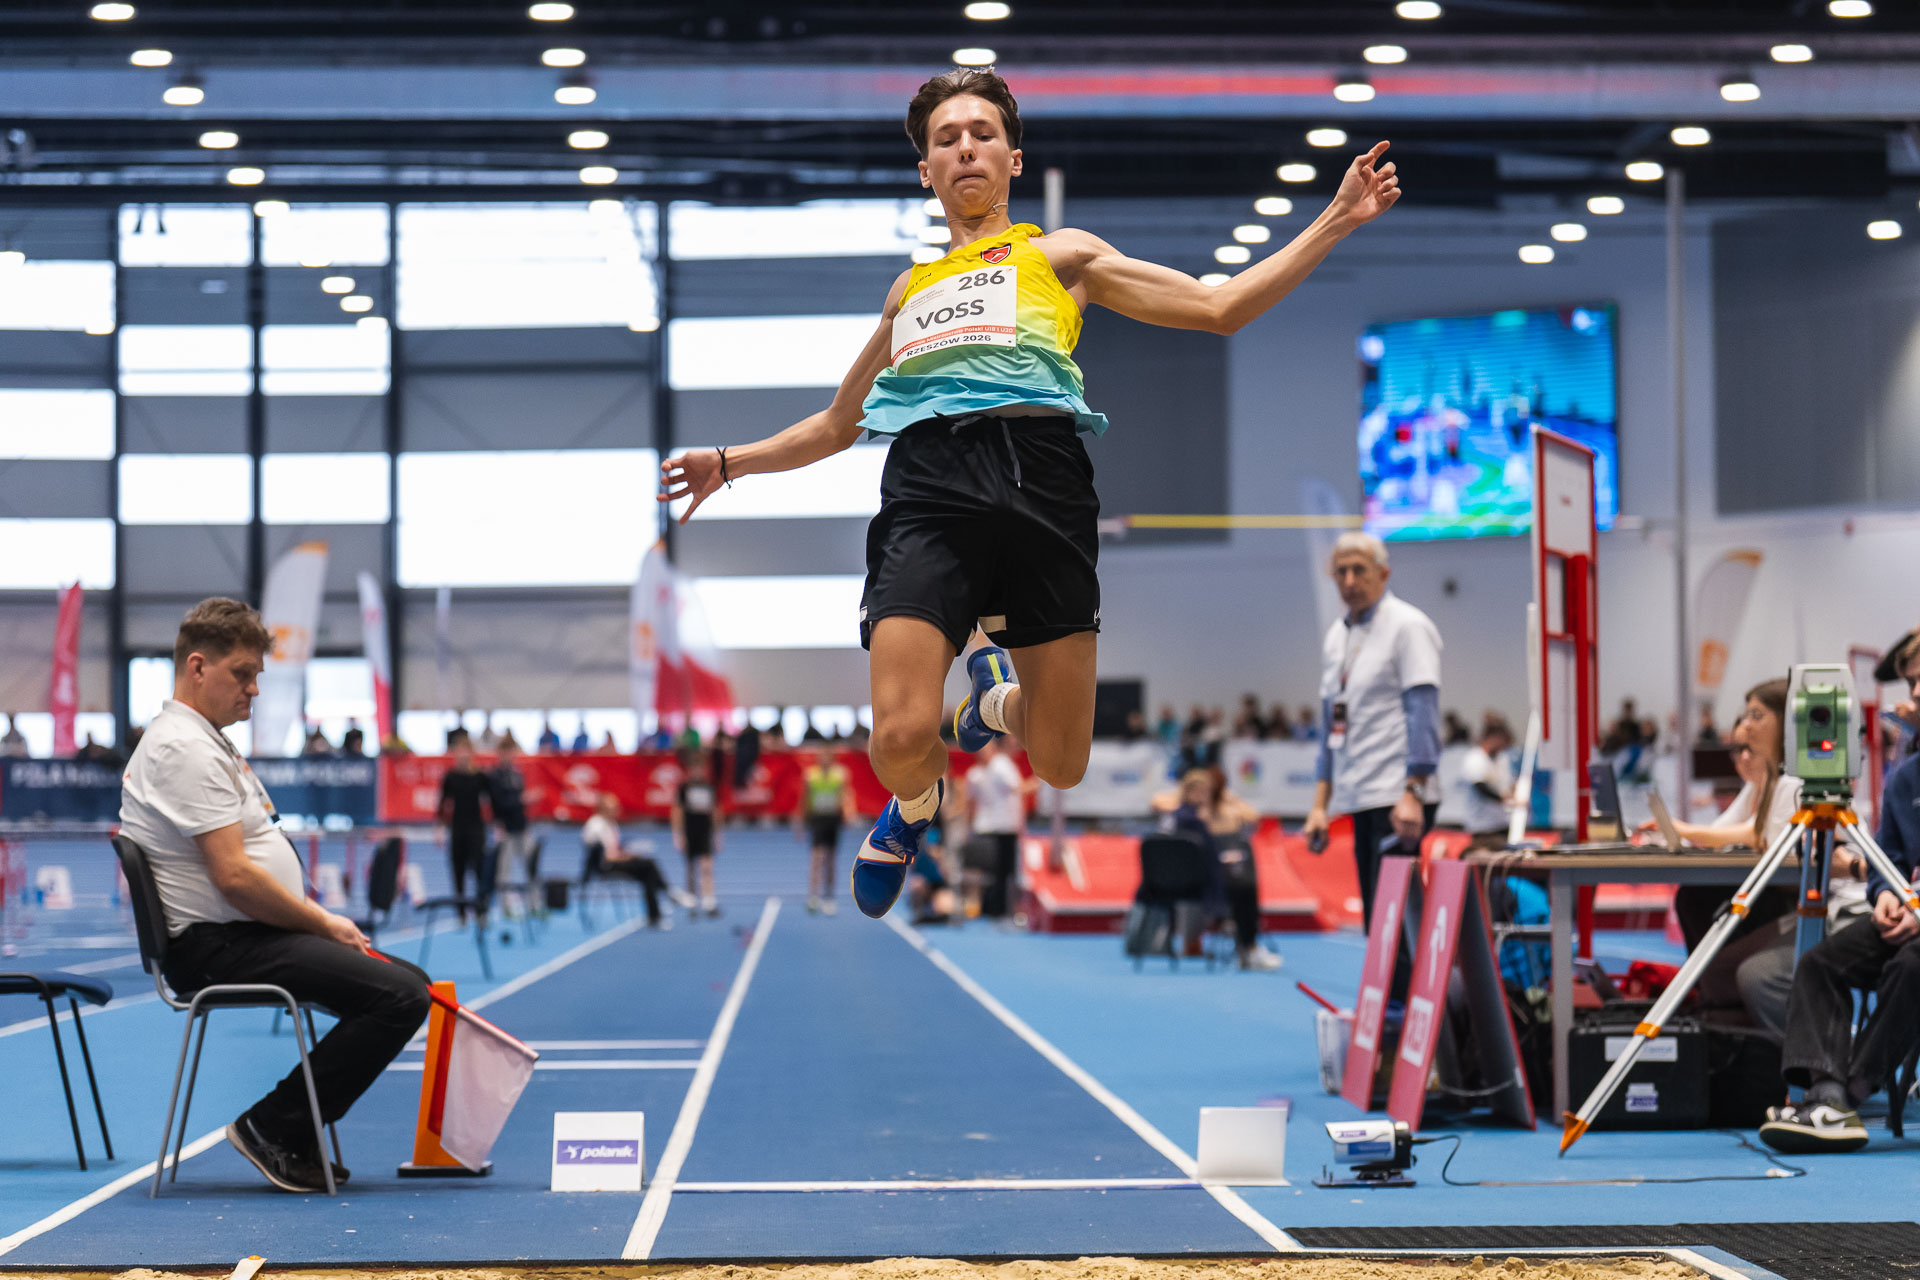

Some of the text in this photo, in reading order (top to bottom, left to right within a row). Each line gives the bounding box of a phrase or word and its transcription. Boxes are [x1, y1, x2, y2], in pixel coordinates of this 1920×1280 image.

[958, 270, 1006, 291] 286
[916, 299, 985, 330] VOSS
[906, 337, 960, 357] RZESZÓW
[963, 334, 992, 342] 2026
[580, 1145, 634, 1160] polanik
